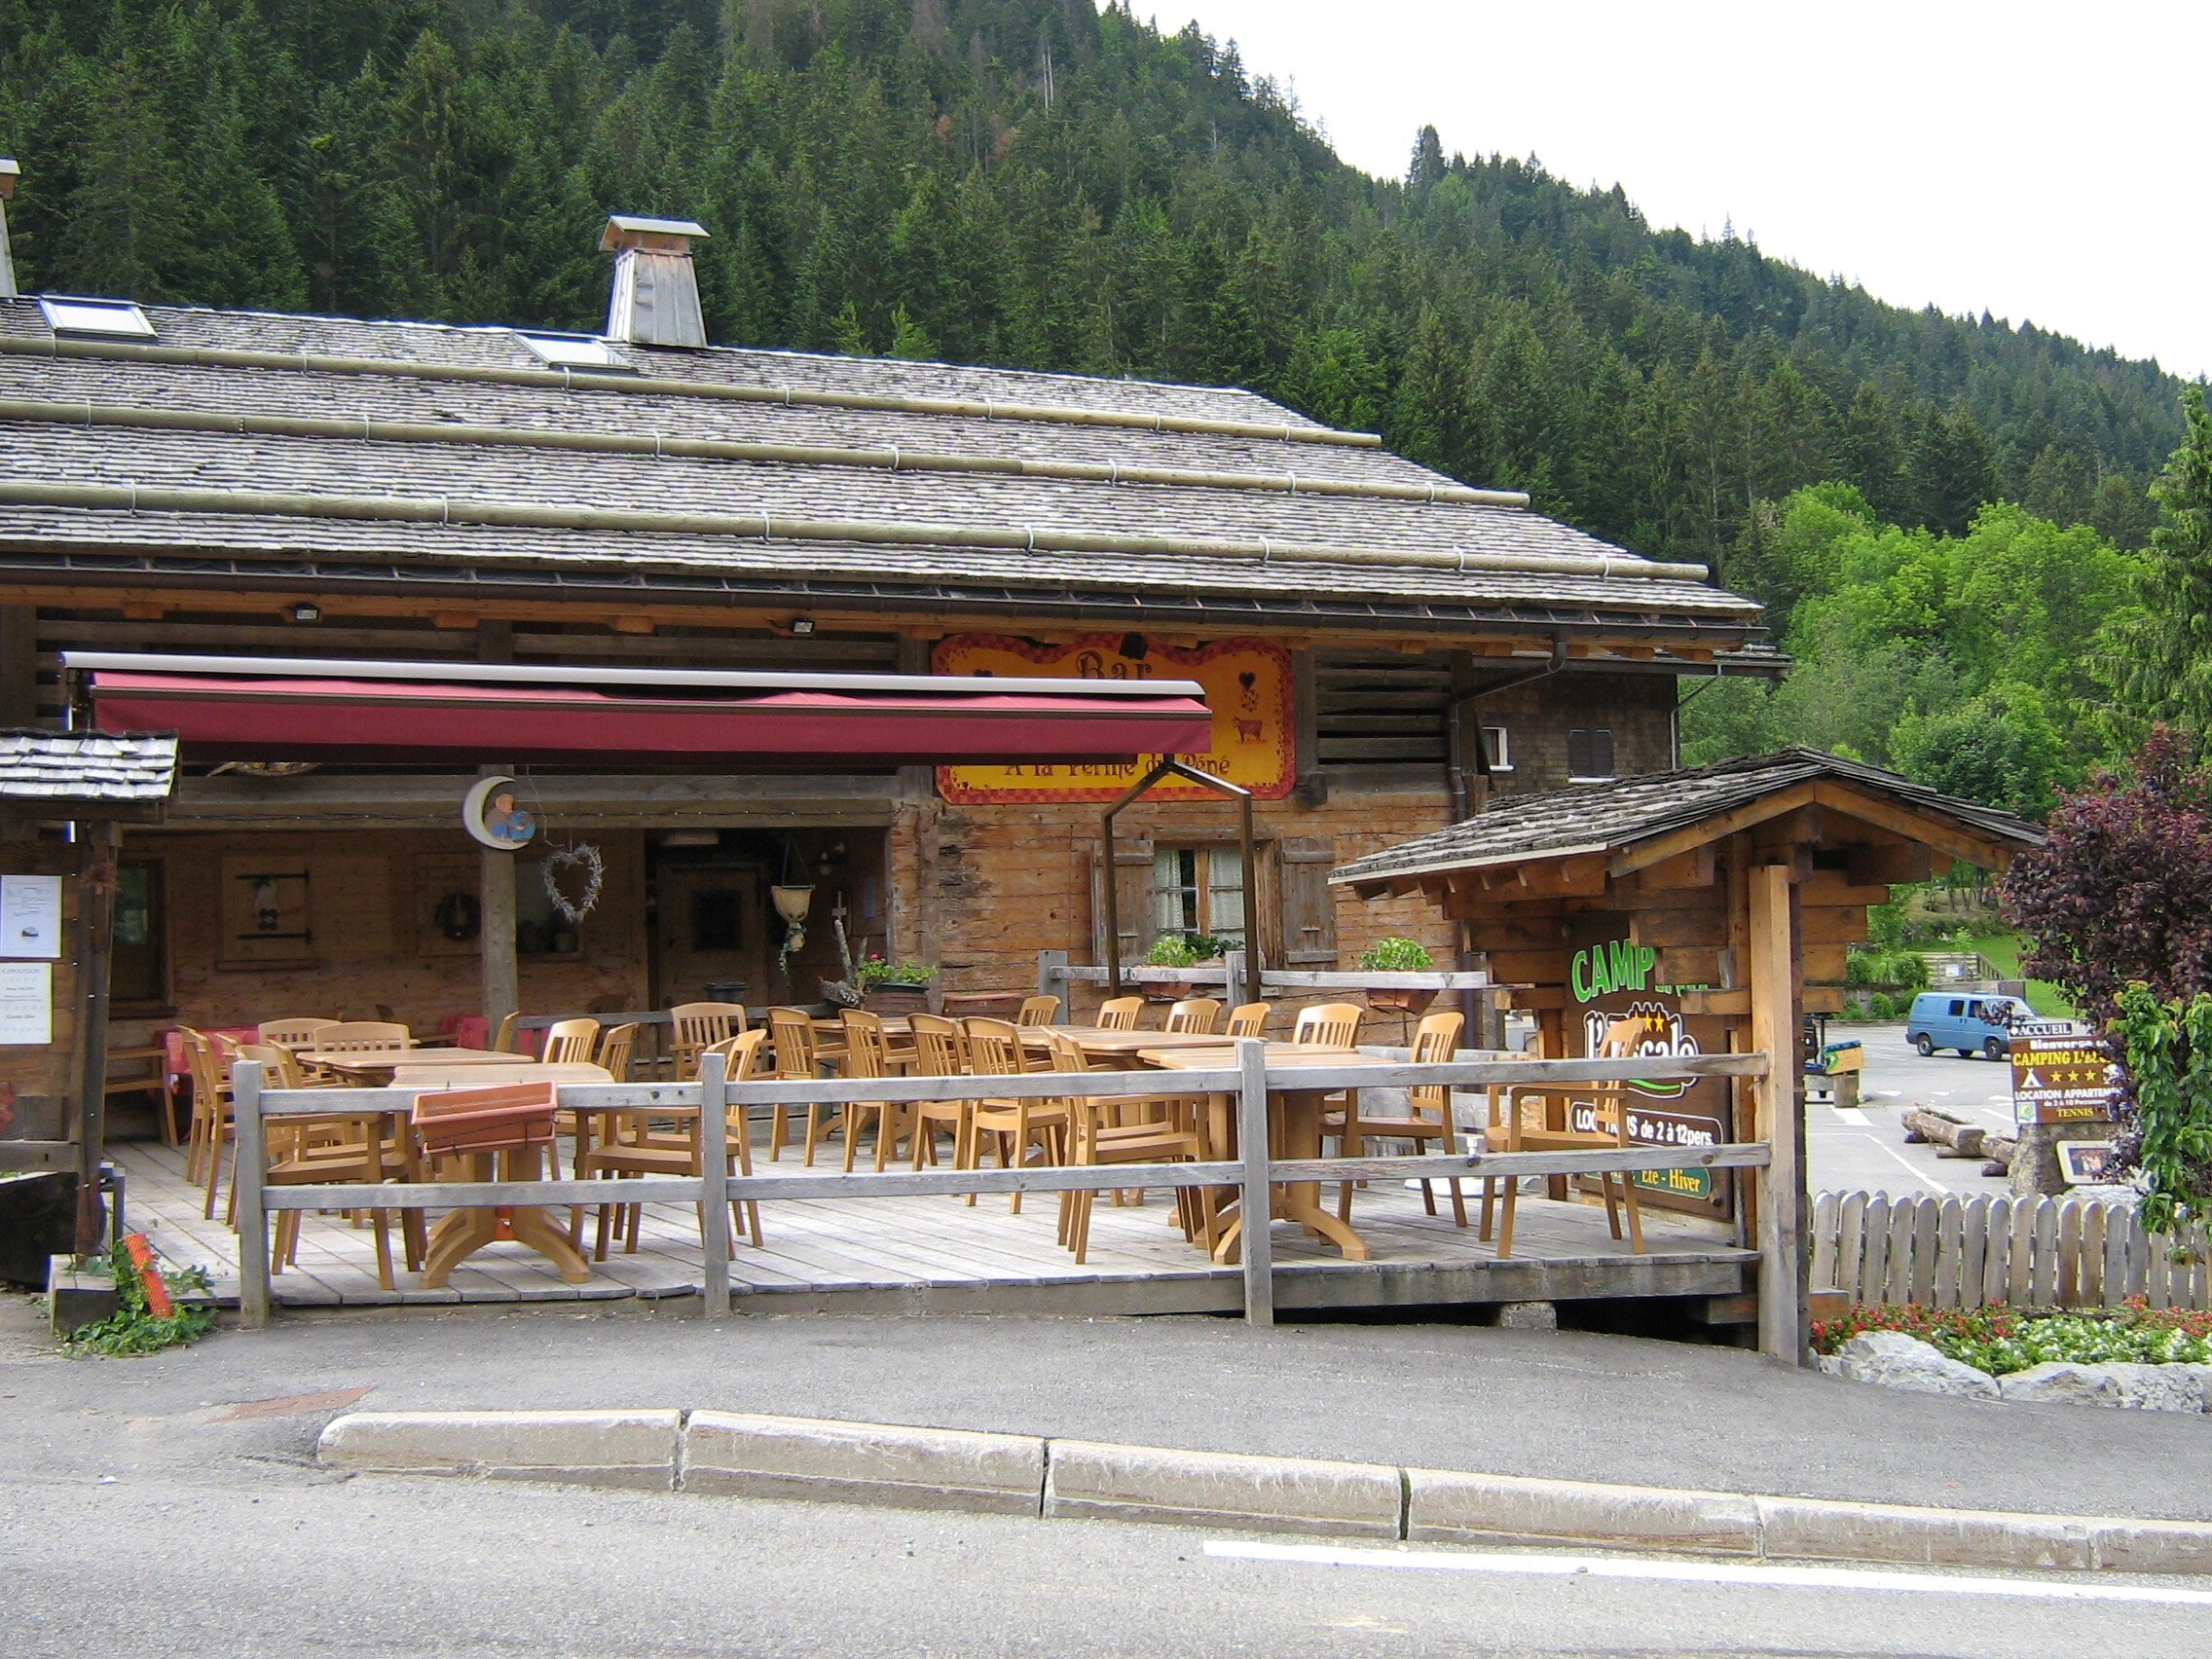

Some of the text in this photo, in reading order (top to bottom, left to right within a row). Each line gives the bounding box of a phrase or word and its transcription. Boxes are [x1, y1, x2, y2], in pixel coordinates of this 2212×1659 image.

[1076, 650, 1153, 680] Bar
[1571, 939, 1709, 1003] CAMP
[2018, 1024, 2071, 1035] ACCUEIL
[2012, 1051, 2071, 1066] CAMPING
[2015, 1089, 2062, 1101] LOCATION
[2056, 1108, 2094, 1118] TENNIS
[1641, 1119, 1654, 1140] de
[1656, 1121, 1664, 1141] 2
[1666, 1122, 1674, 1142] à
[1669, 1168, 1701, 1193] Hiver
